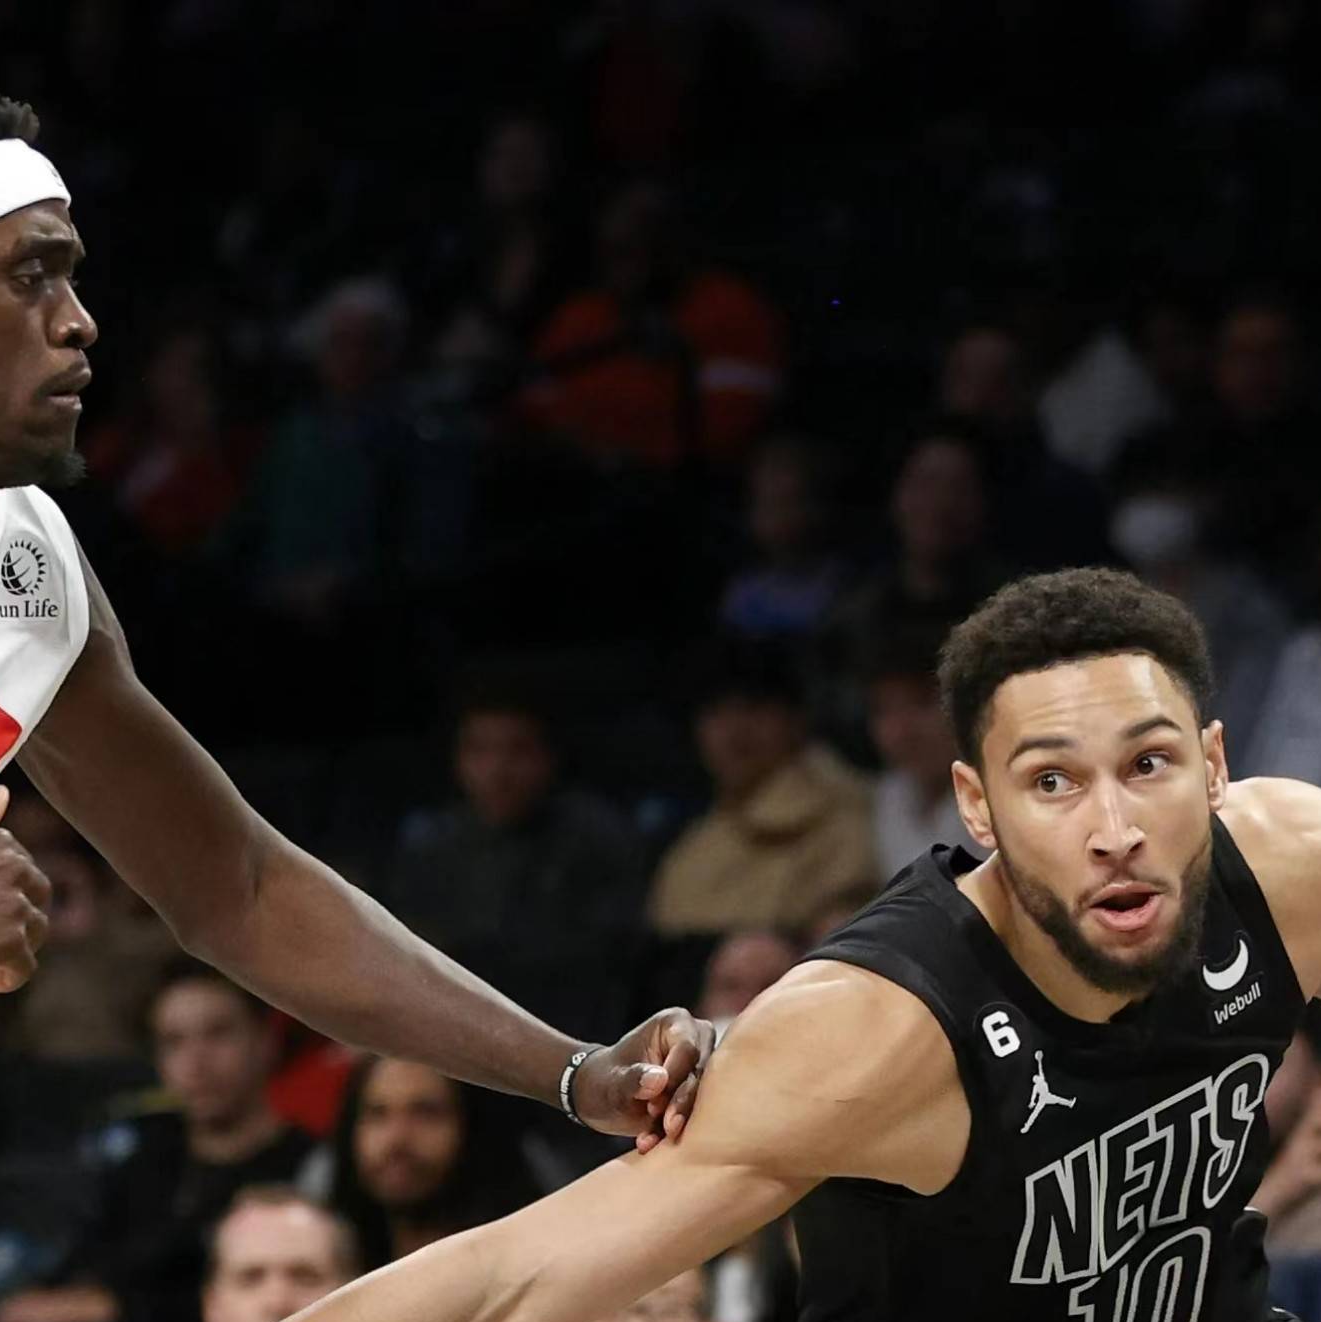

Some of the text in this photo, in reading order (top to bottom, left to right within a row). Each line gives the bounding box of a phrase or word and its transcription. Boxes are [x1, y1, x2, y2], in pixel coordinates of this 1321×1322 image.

[24, 598, 59, 618] Life
[1213, 981, 1262, 1025] Webull
[981, 1010, 1021, 1058] 6
[1010, 1053, 1270, 1284] NETS
